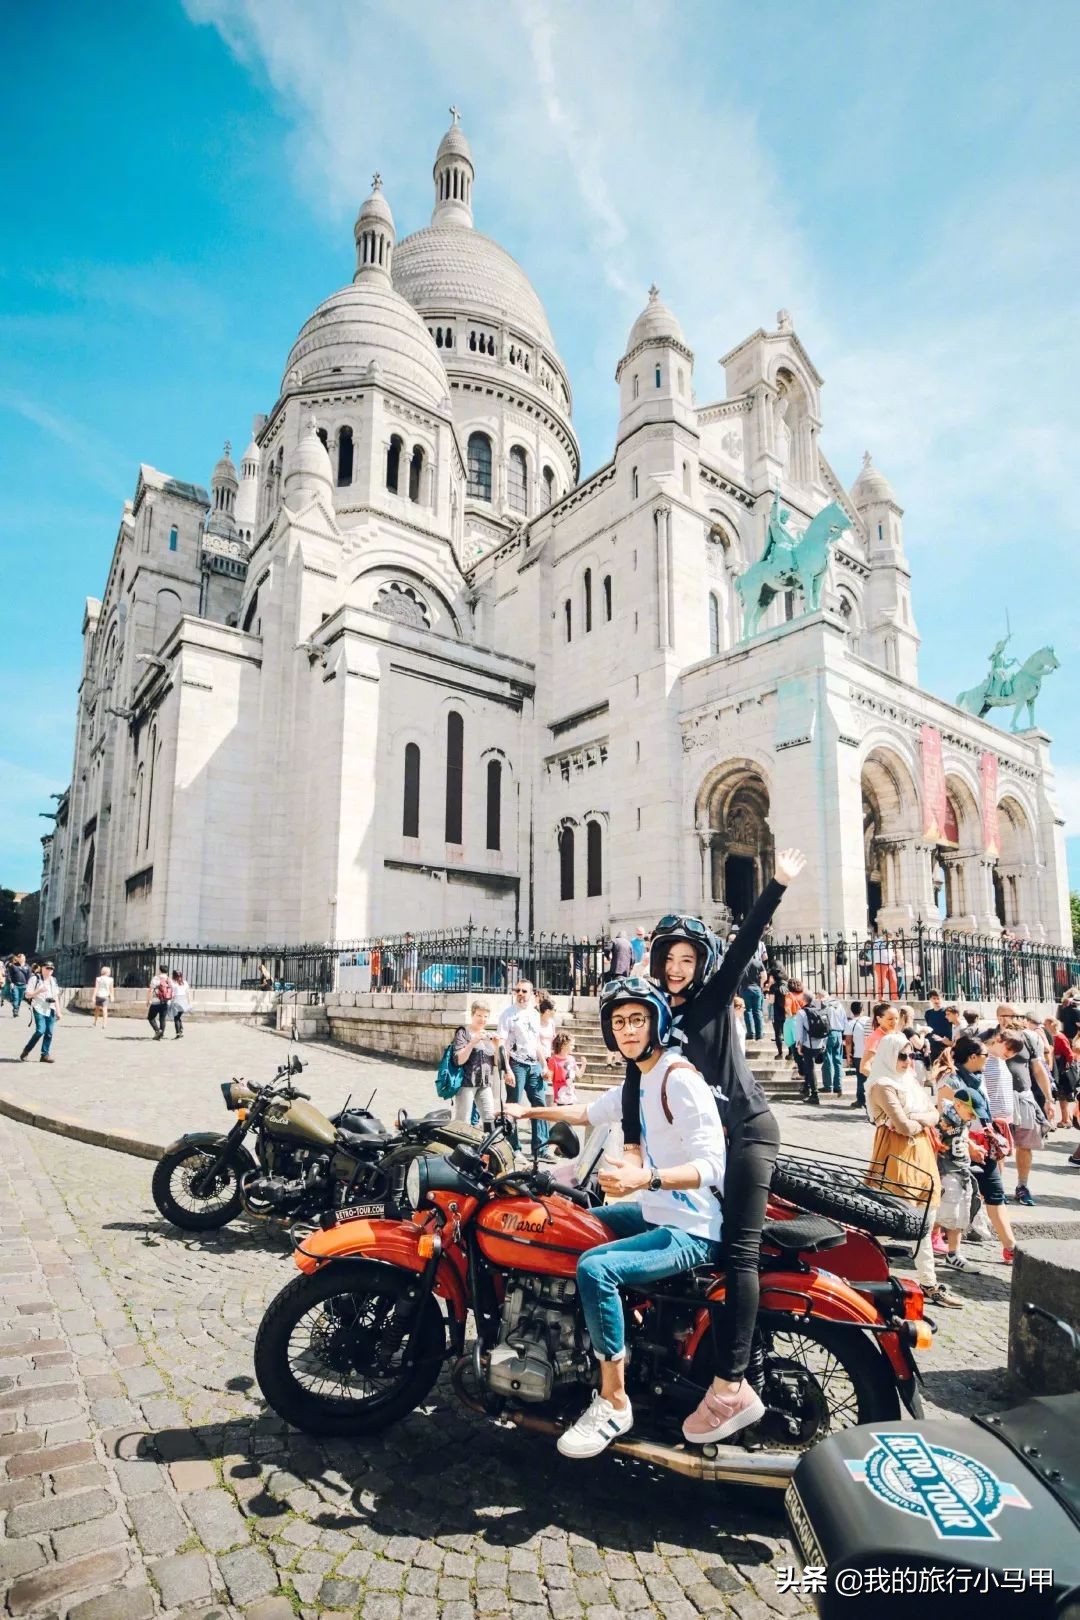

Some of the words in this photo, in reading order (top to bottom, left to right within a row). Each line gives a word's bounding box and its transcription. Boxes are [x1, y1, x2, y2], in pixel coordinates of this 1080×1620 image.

[335, 1206, 385, 1220] RETRO-TOUR.COM
[502, 1213, 547, 1233] Marcel
[885, 1437, 938, 1477] RETRO
[920, 1482, 977, 1529] TOUR
